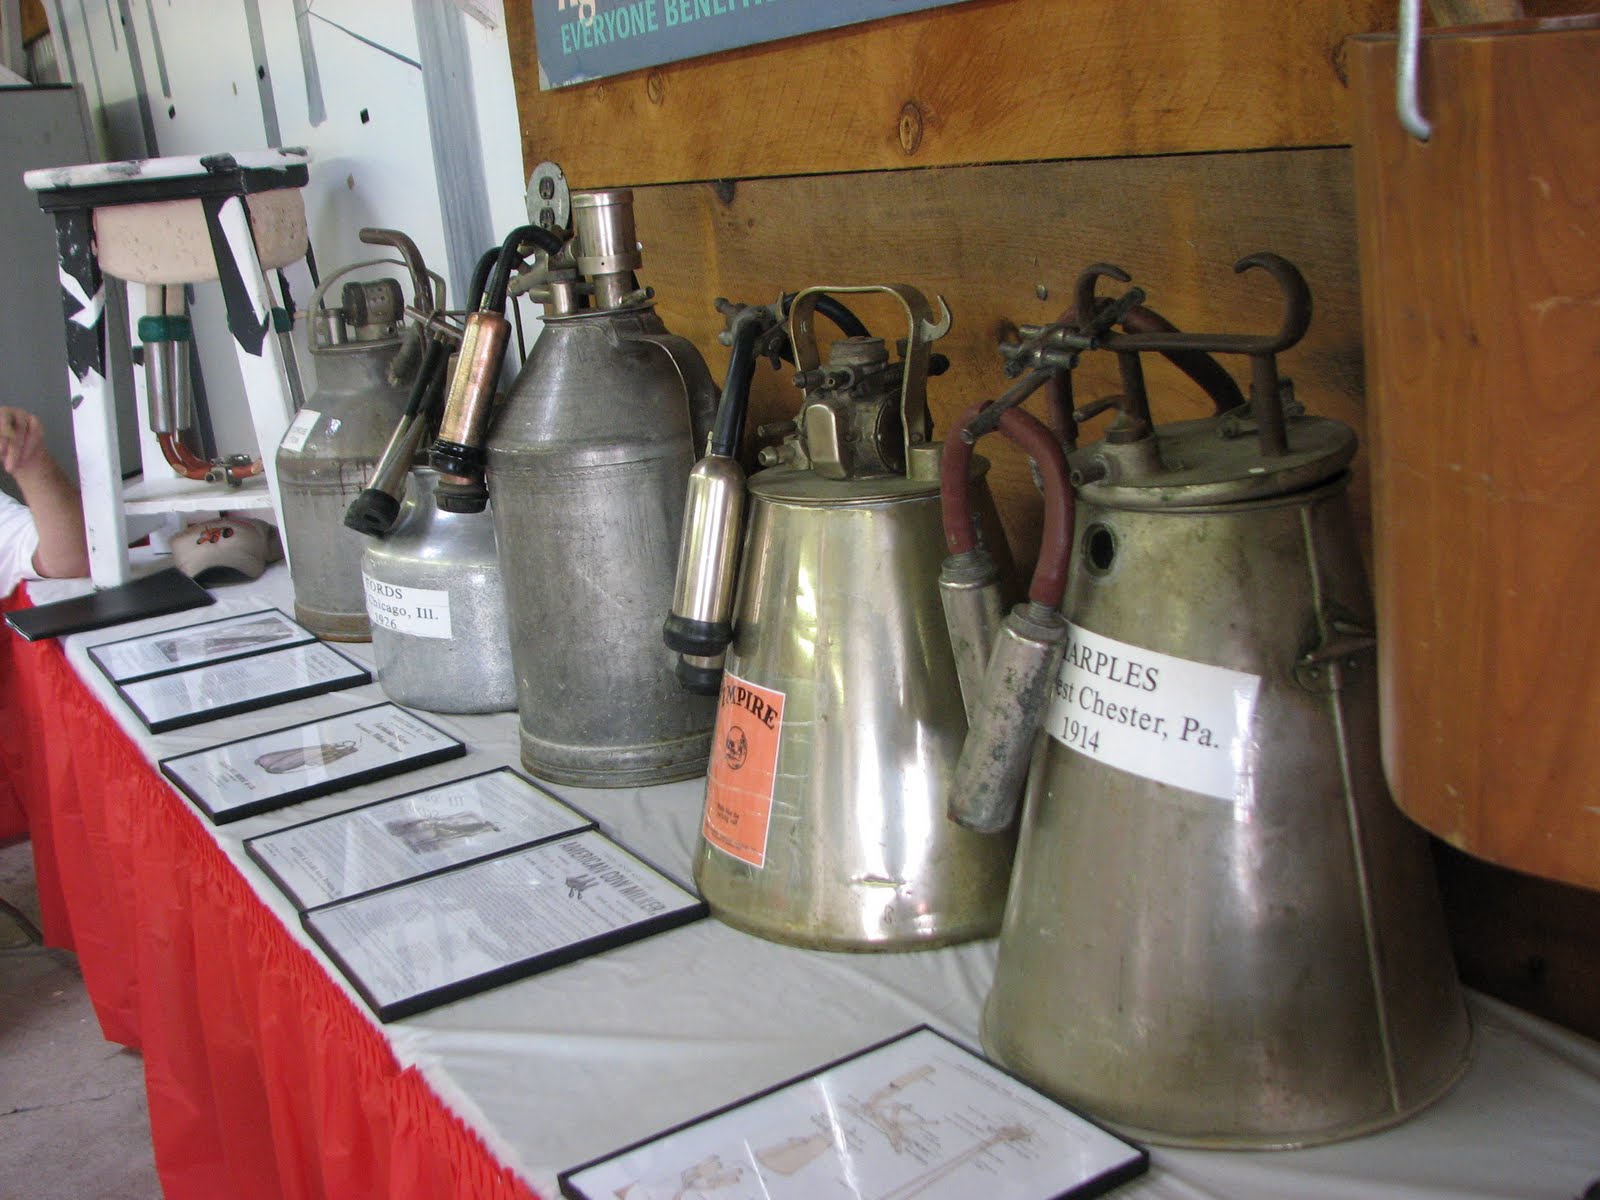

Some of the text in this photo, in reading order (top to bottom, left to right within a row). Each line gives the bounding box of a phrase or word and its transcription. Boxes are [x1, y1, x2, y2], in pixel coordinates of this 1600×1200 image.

[561, 0, 658, 55] EVERYONE
[368, 594, 439, 620] Chicago, Ill.
[375, 612, 397, 630] 1926
[1062, 637, 1160, 692] ARPLES
[1056, 675, 1219, 748] est Chester, Pa.
[1061, 716, 1100, 753] 1914
